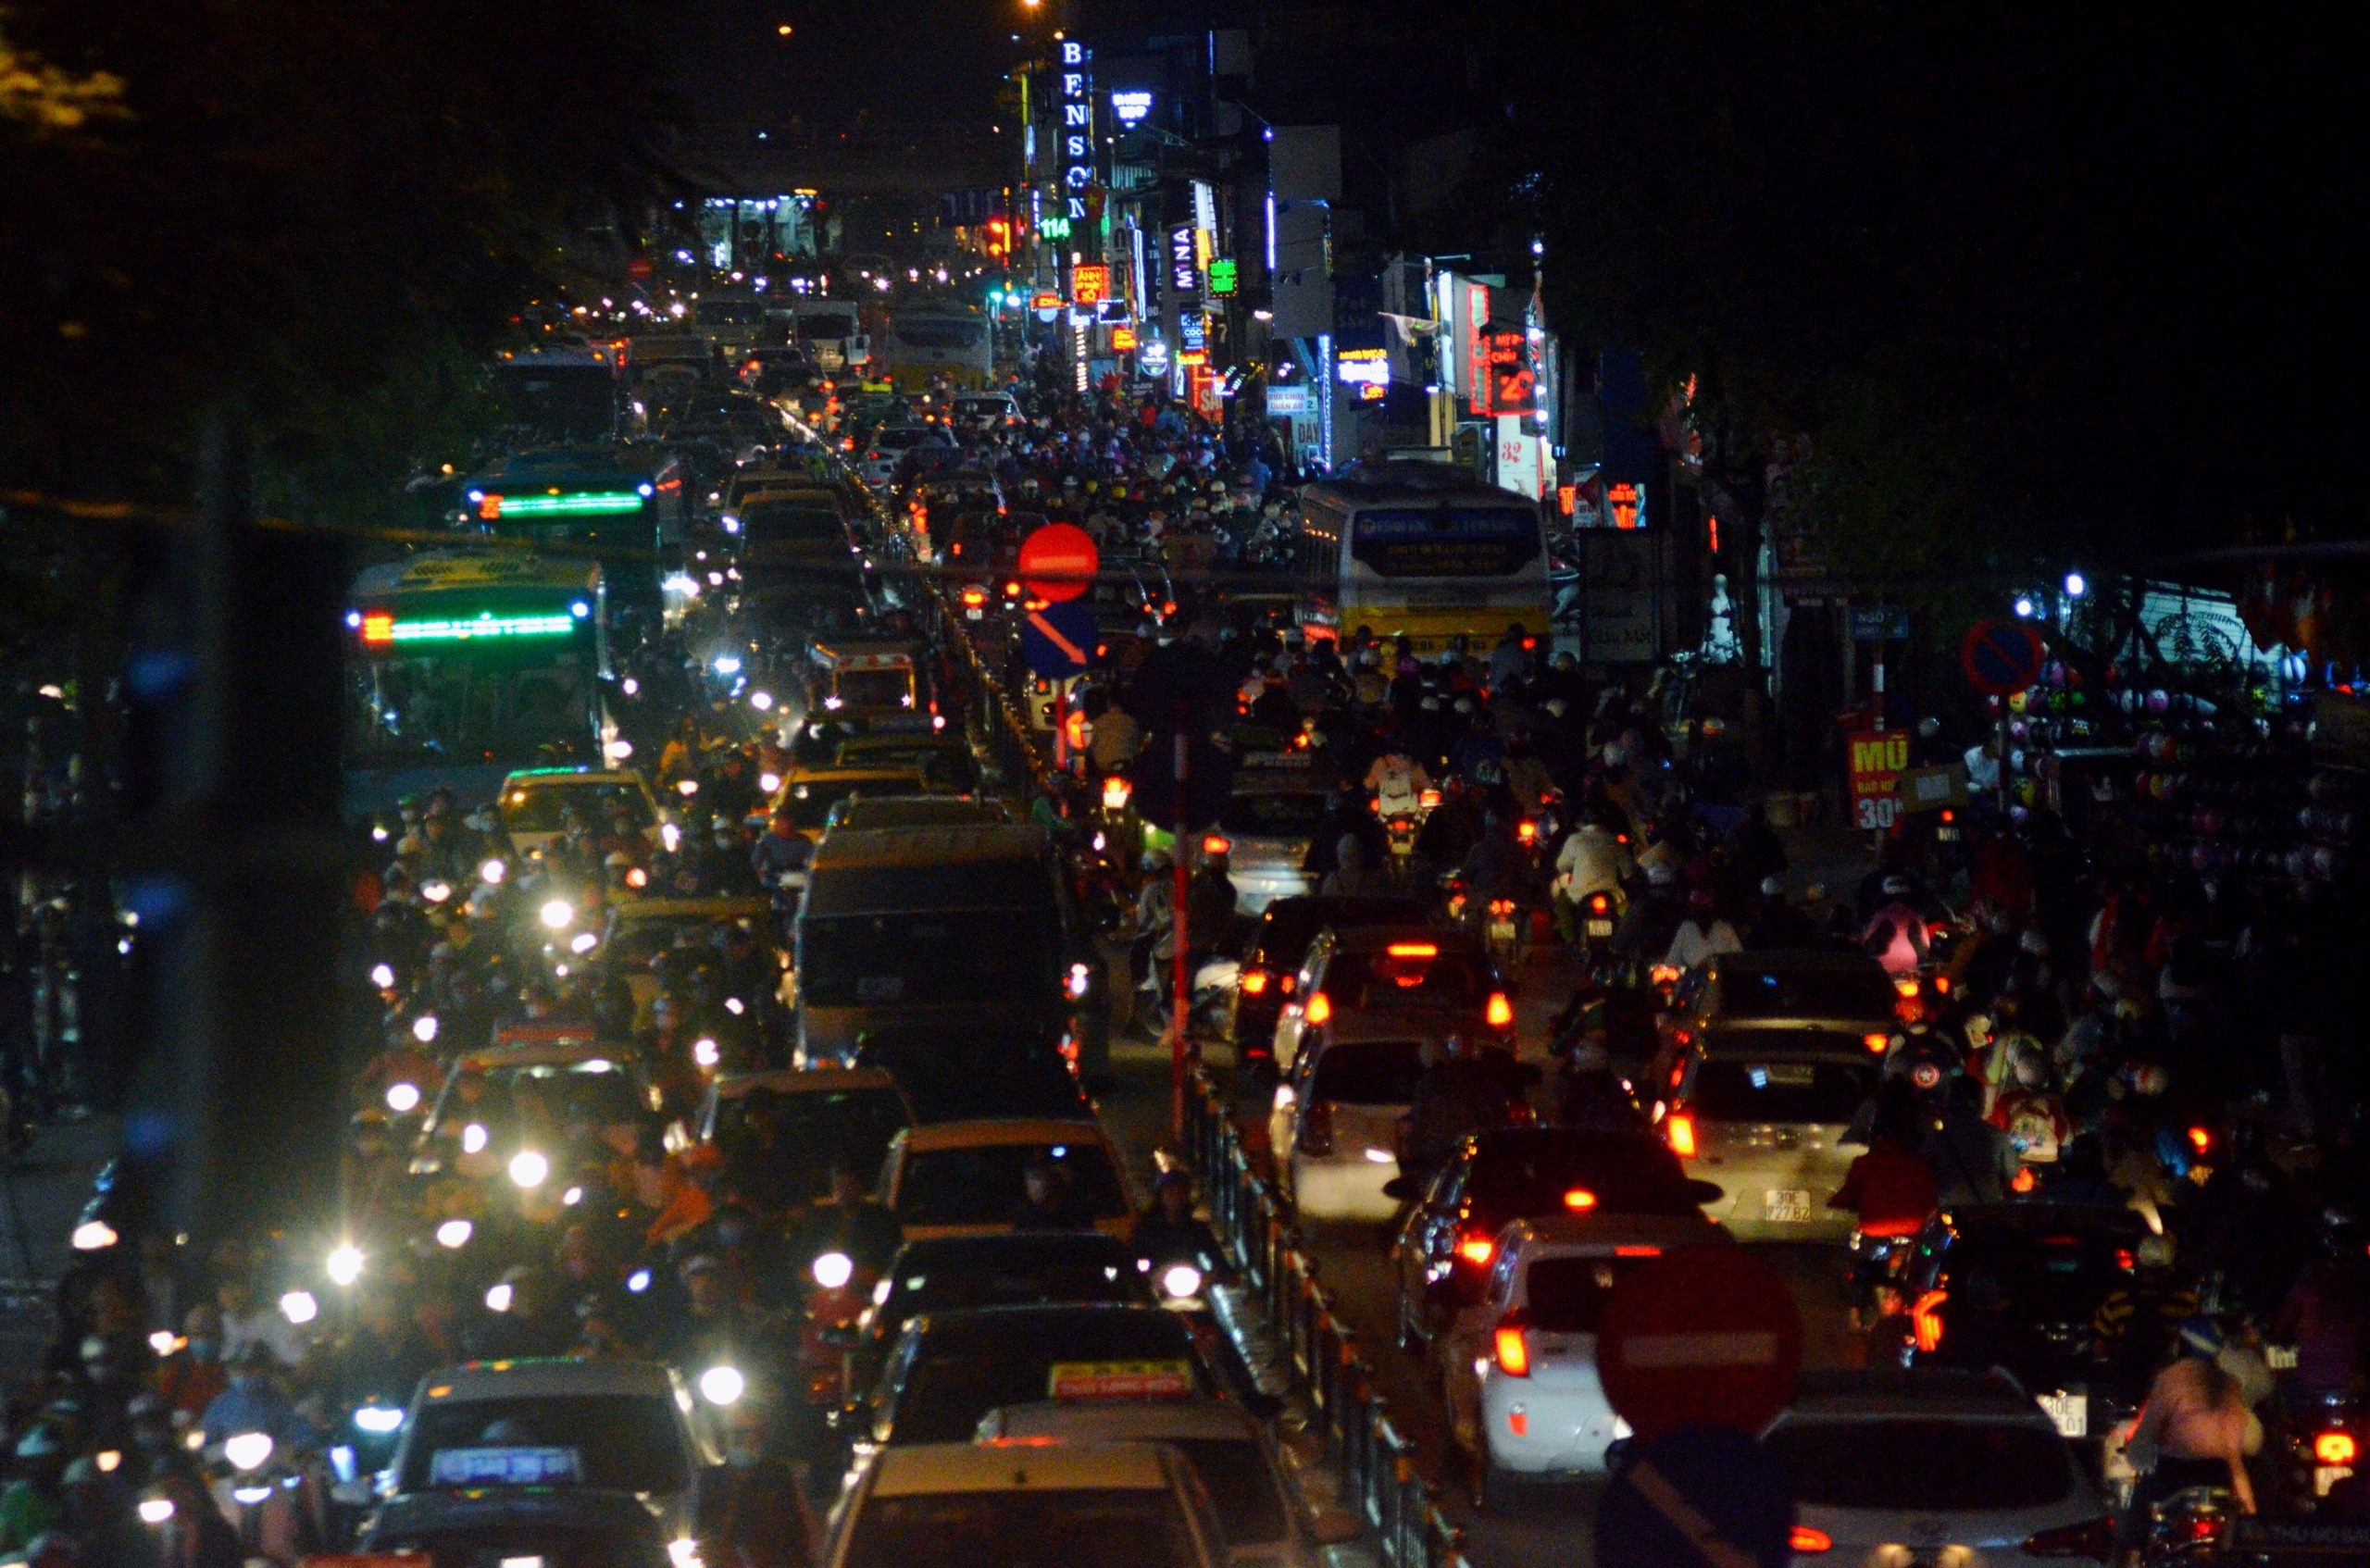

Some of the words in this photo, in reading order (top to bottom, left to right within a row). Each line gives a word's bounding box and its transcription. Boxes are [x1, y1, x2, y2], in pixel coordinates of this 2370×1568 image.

[1041, 218, 1070, 239] 114
[1502, 441, 1521, 464] 32
[1853, 734, 1908, 772] MŨ
